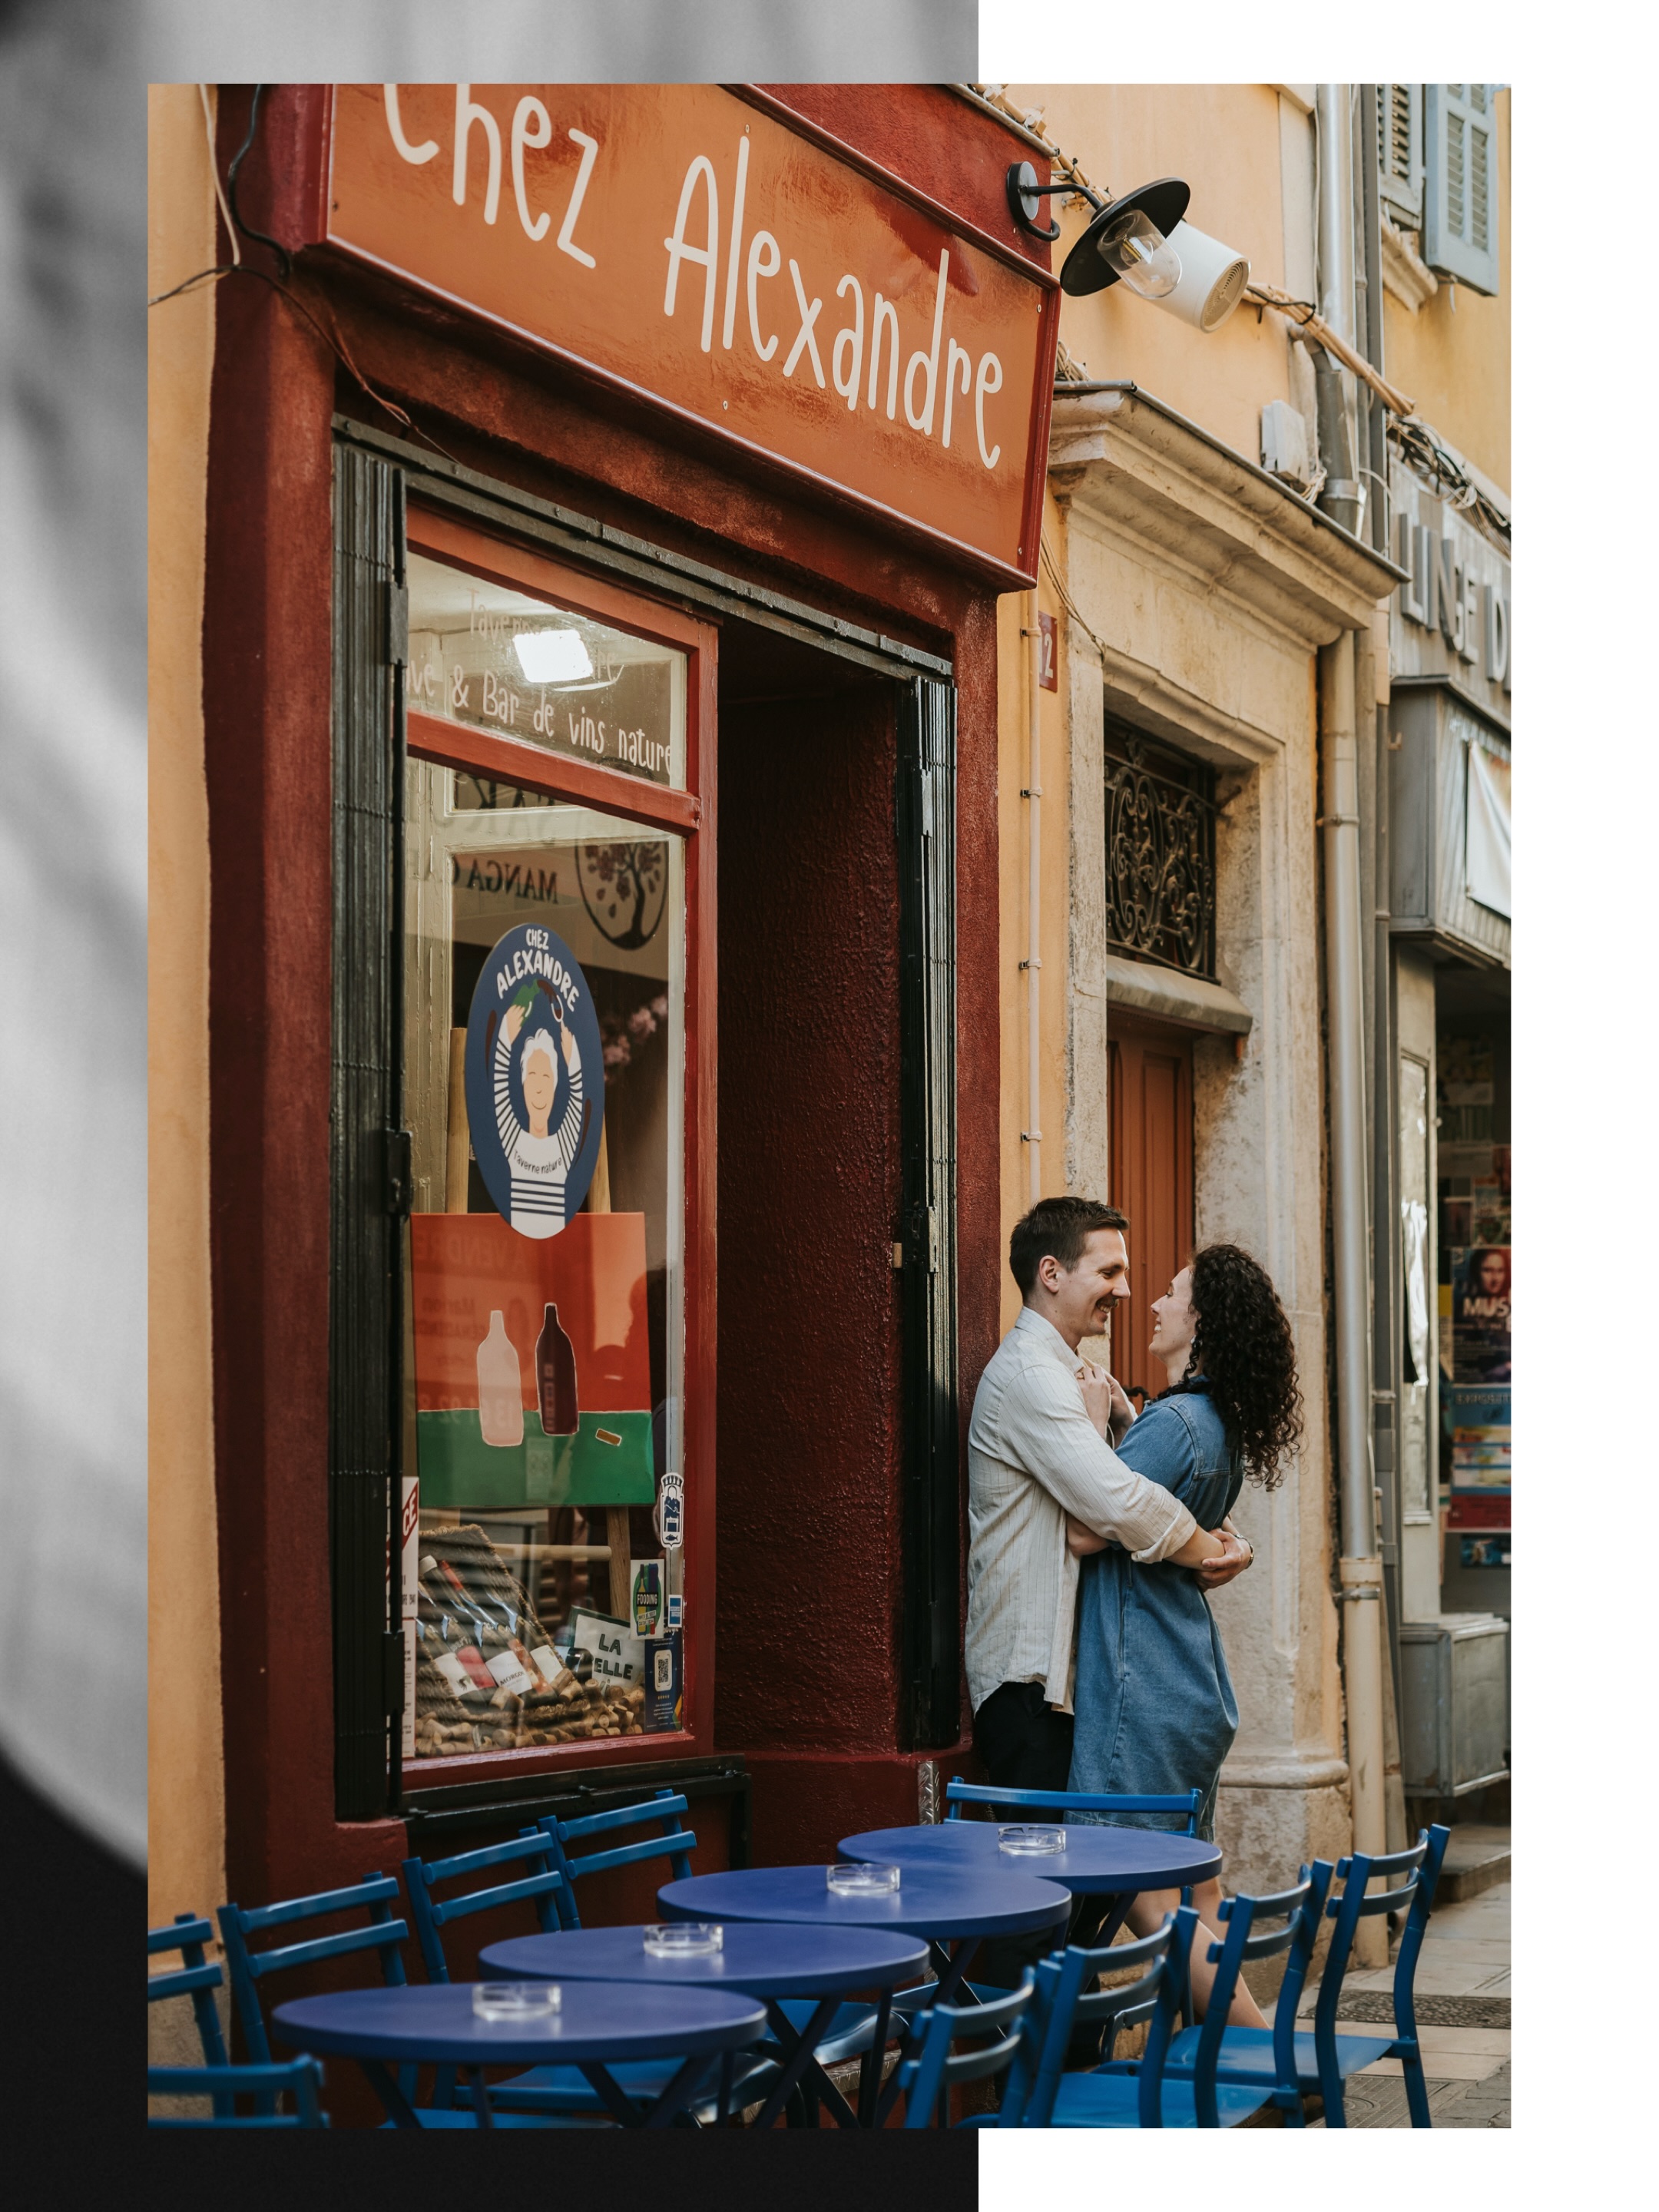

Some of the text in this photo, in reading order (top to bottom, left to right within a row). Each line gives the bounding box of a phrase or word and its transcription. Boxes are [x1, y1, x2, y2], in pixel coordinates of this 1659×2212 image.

[384, 84, 1004, 470] Chez Alexandre
[406, 659, 435, 697] ve
[452, 664, 470, 708] &
[482, 669, 519, 726] Bar
[533, 685, 555, 737] de
[568, 706, 605, 754] vins
[525, 928, 550, 951] CHEZ
[496, 949, 580, 1012] ALEXANDRE
[514, 1149, 562, 1174] Taverne nature
[1463, 1296, 1511, 1317] MUS
[637, 1594, 658, 1605] FOODING
[598, 1633, 621, 1656] LA
[593, 1657, 634, 1681] ELLE
